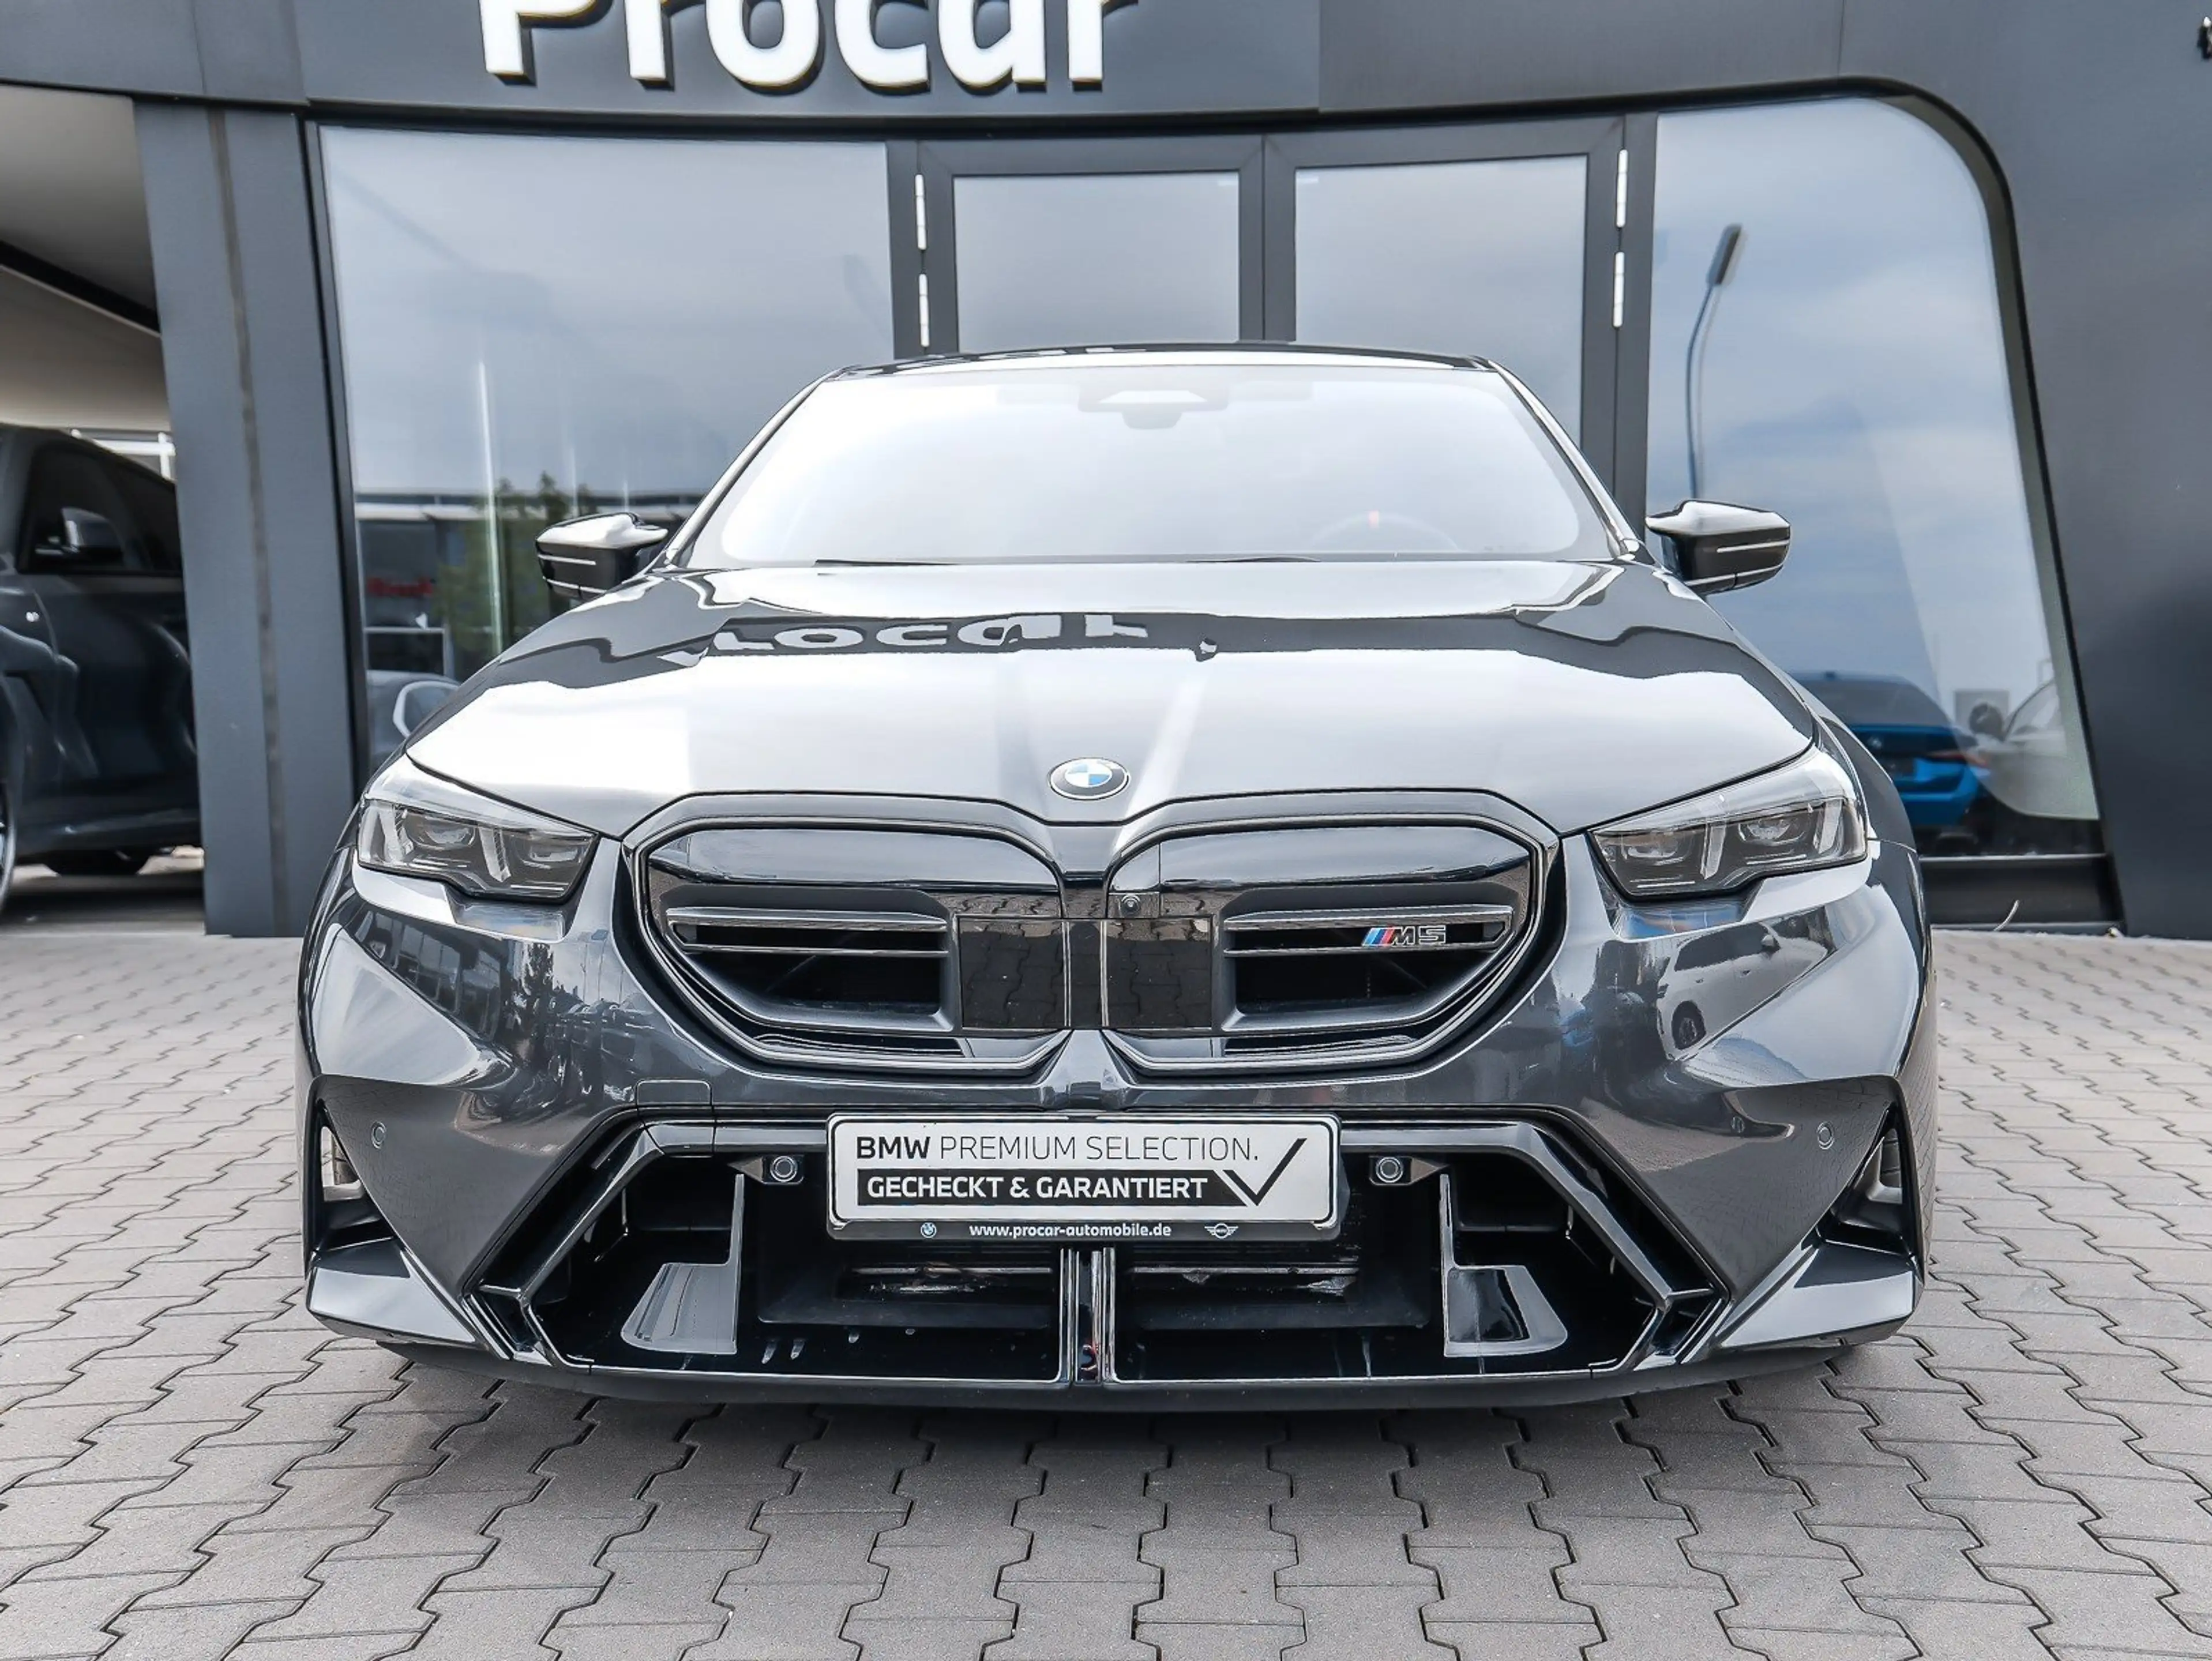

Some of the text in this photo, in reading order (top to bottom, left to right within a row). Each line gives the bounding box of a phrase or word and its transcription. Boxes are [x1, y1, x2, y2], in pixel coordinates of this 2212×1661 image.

[1387, 925, 1447, 947] M5
[857, 1136, 1258, 1161] BMW PREMIUM SELECTION.
[867, 1176, 1208, 1199] GECHECKT & GARANTIERT
[969, 1222, 1172, 1239] www.procar-automobile.de
